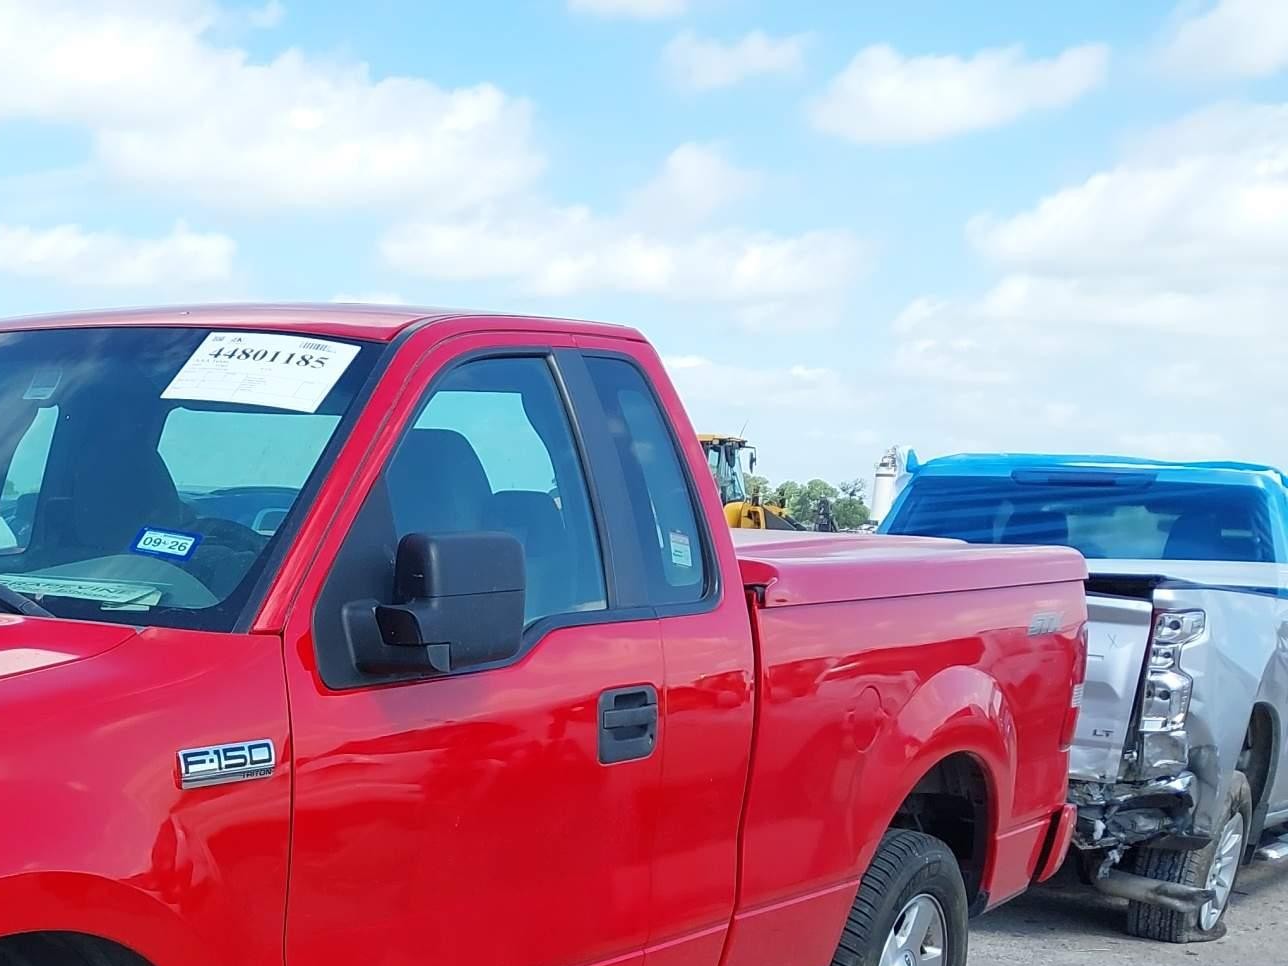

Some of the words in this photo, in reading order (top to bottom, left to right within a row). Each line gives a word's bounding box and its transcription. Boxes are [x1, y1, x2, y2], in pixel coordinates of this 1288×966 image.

[208, 346, 329, 369] 44801185
[142, 536, 162, 548] 09
[168, 540, 189, 552] 26
[1092, 728, 1114, 738] LT
